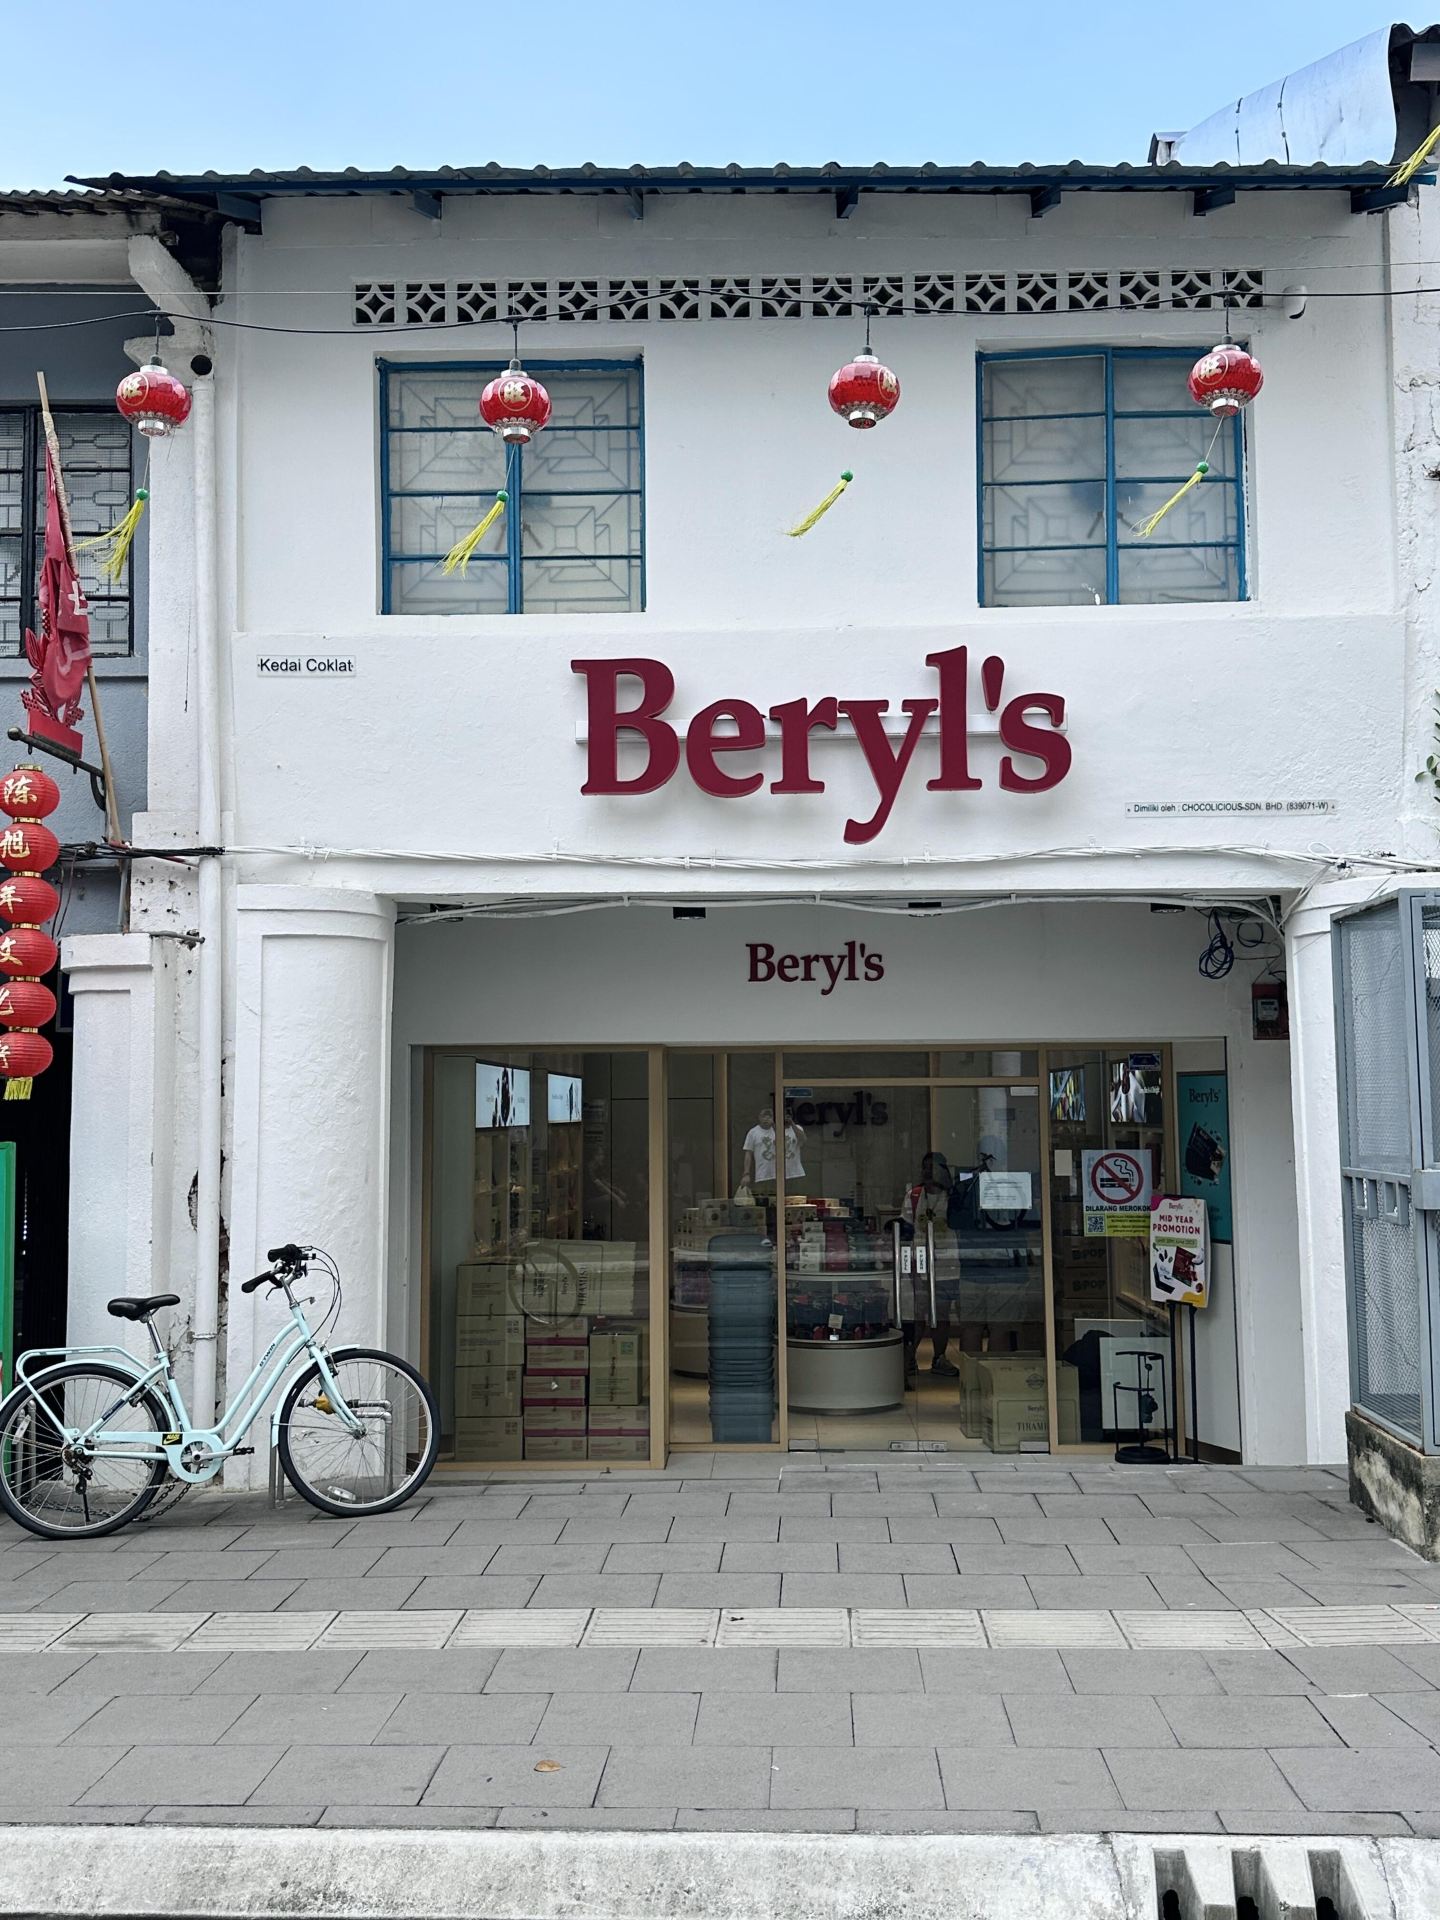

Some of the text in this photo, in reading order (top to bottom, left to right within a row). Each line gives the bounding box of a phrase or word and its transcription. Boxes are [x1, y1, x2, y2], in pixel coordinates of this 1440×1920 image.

[260, 658, 353, 672] Kedai Coklat
[570, 645, 1072, 845] Beryl's
[1133, 804, 1159, 813] Dimiliki
[1160, 804, 1176, 812] oleh
[1181, 802, 1243, 812] CHOCOLICIOUS
[1286, 801, 1329, 812] (839071-W)
[745, 940, 885, 996] Beryl's
[1159, 1214, 1194, 1224] MID YEAR
[1152, 1223, 1201, 1235] PROMOTION
[1016, 1421, 1047, 1432] TIRAMI
